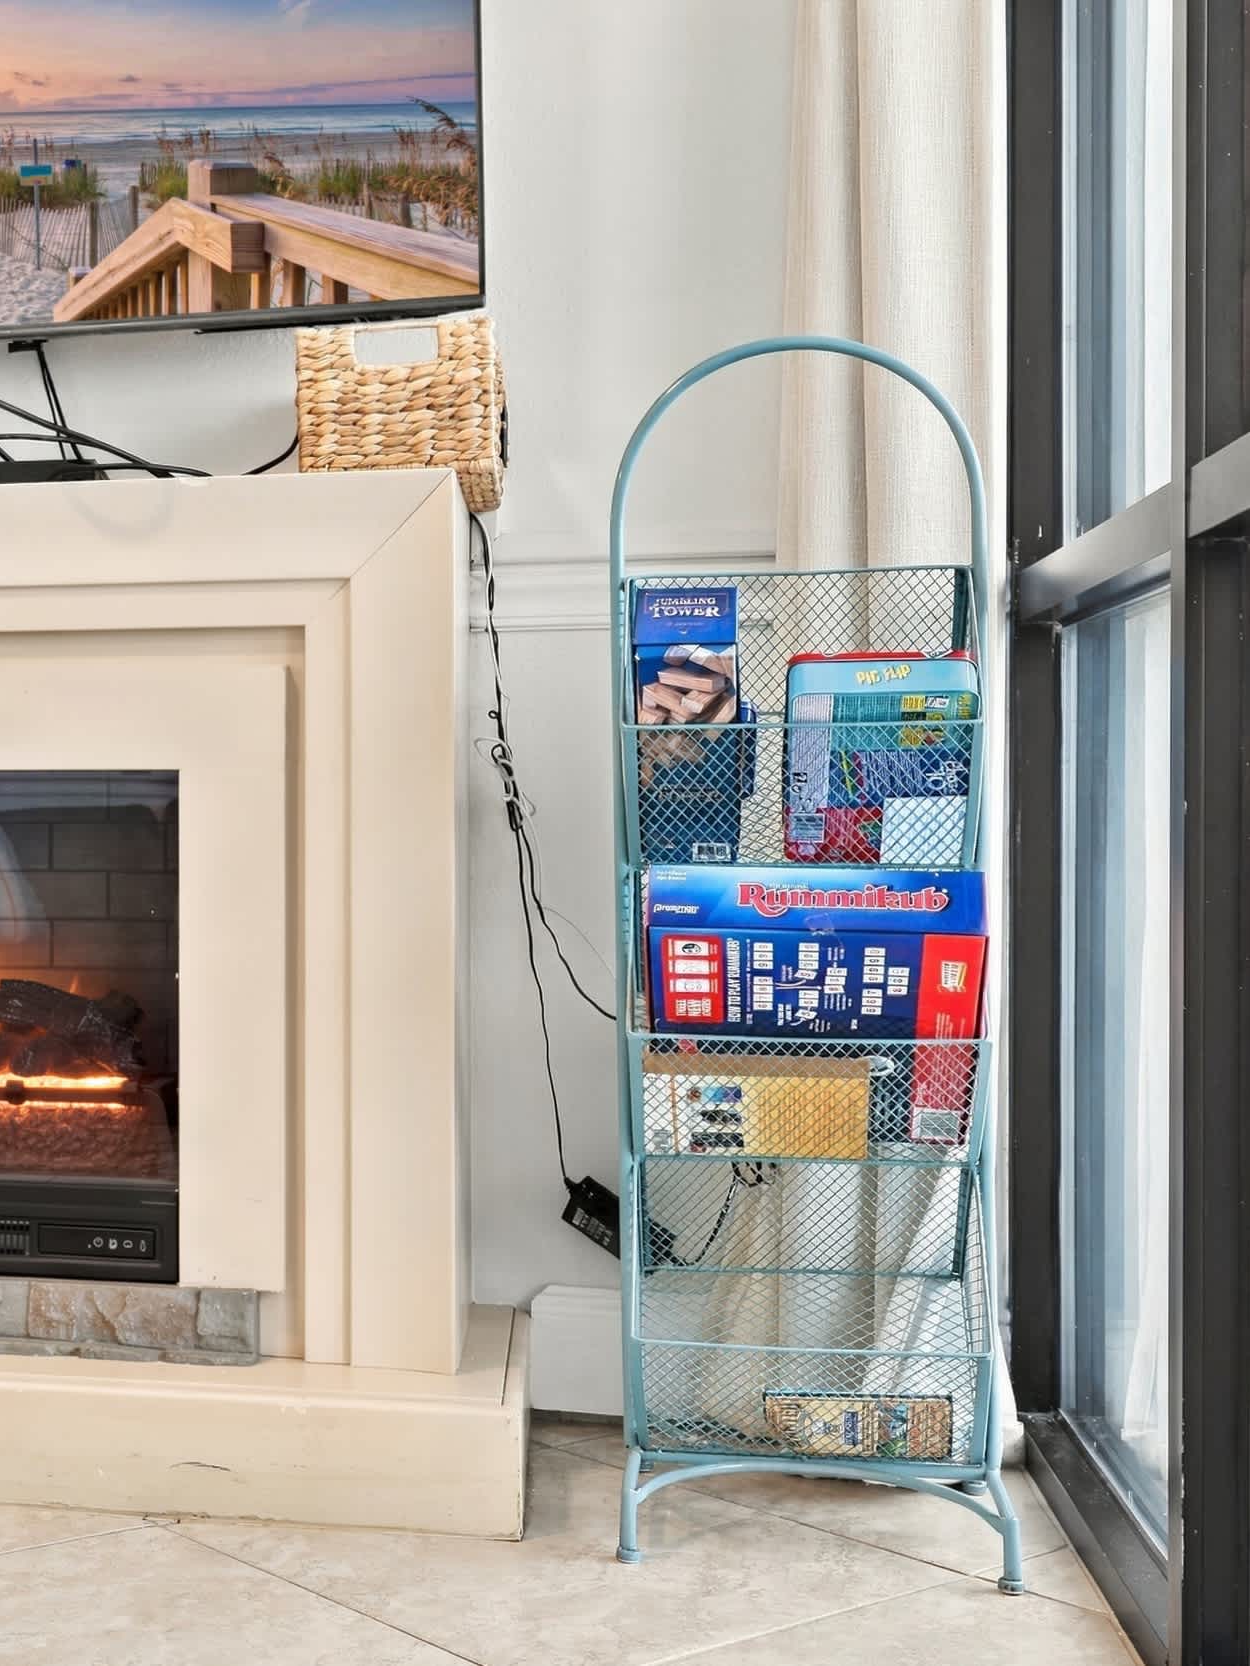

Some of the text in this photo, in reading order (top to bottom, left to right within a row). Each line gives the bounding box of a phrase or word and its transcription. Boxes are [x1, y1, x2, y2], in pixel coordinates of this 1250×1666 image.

[648, 605, 722, 618] TOWER
[737, 882, 950, 918] Rummikub
[727, 978, 741, 995] PLAY
[727, 995, 741, 1005] TO
